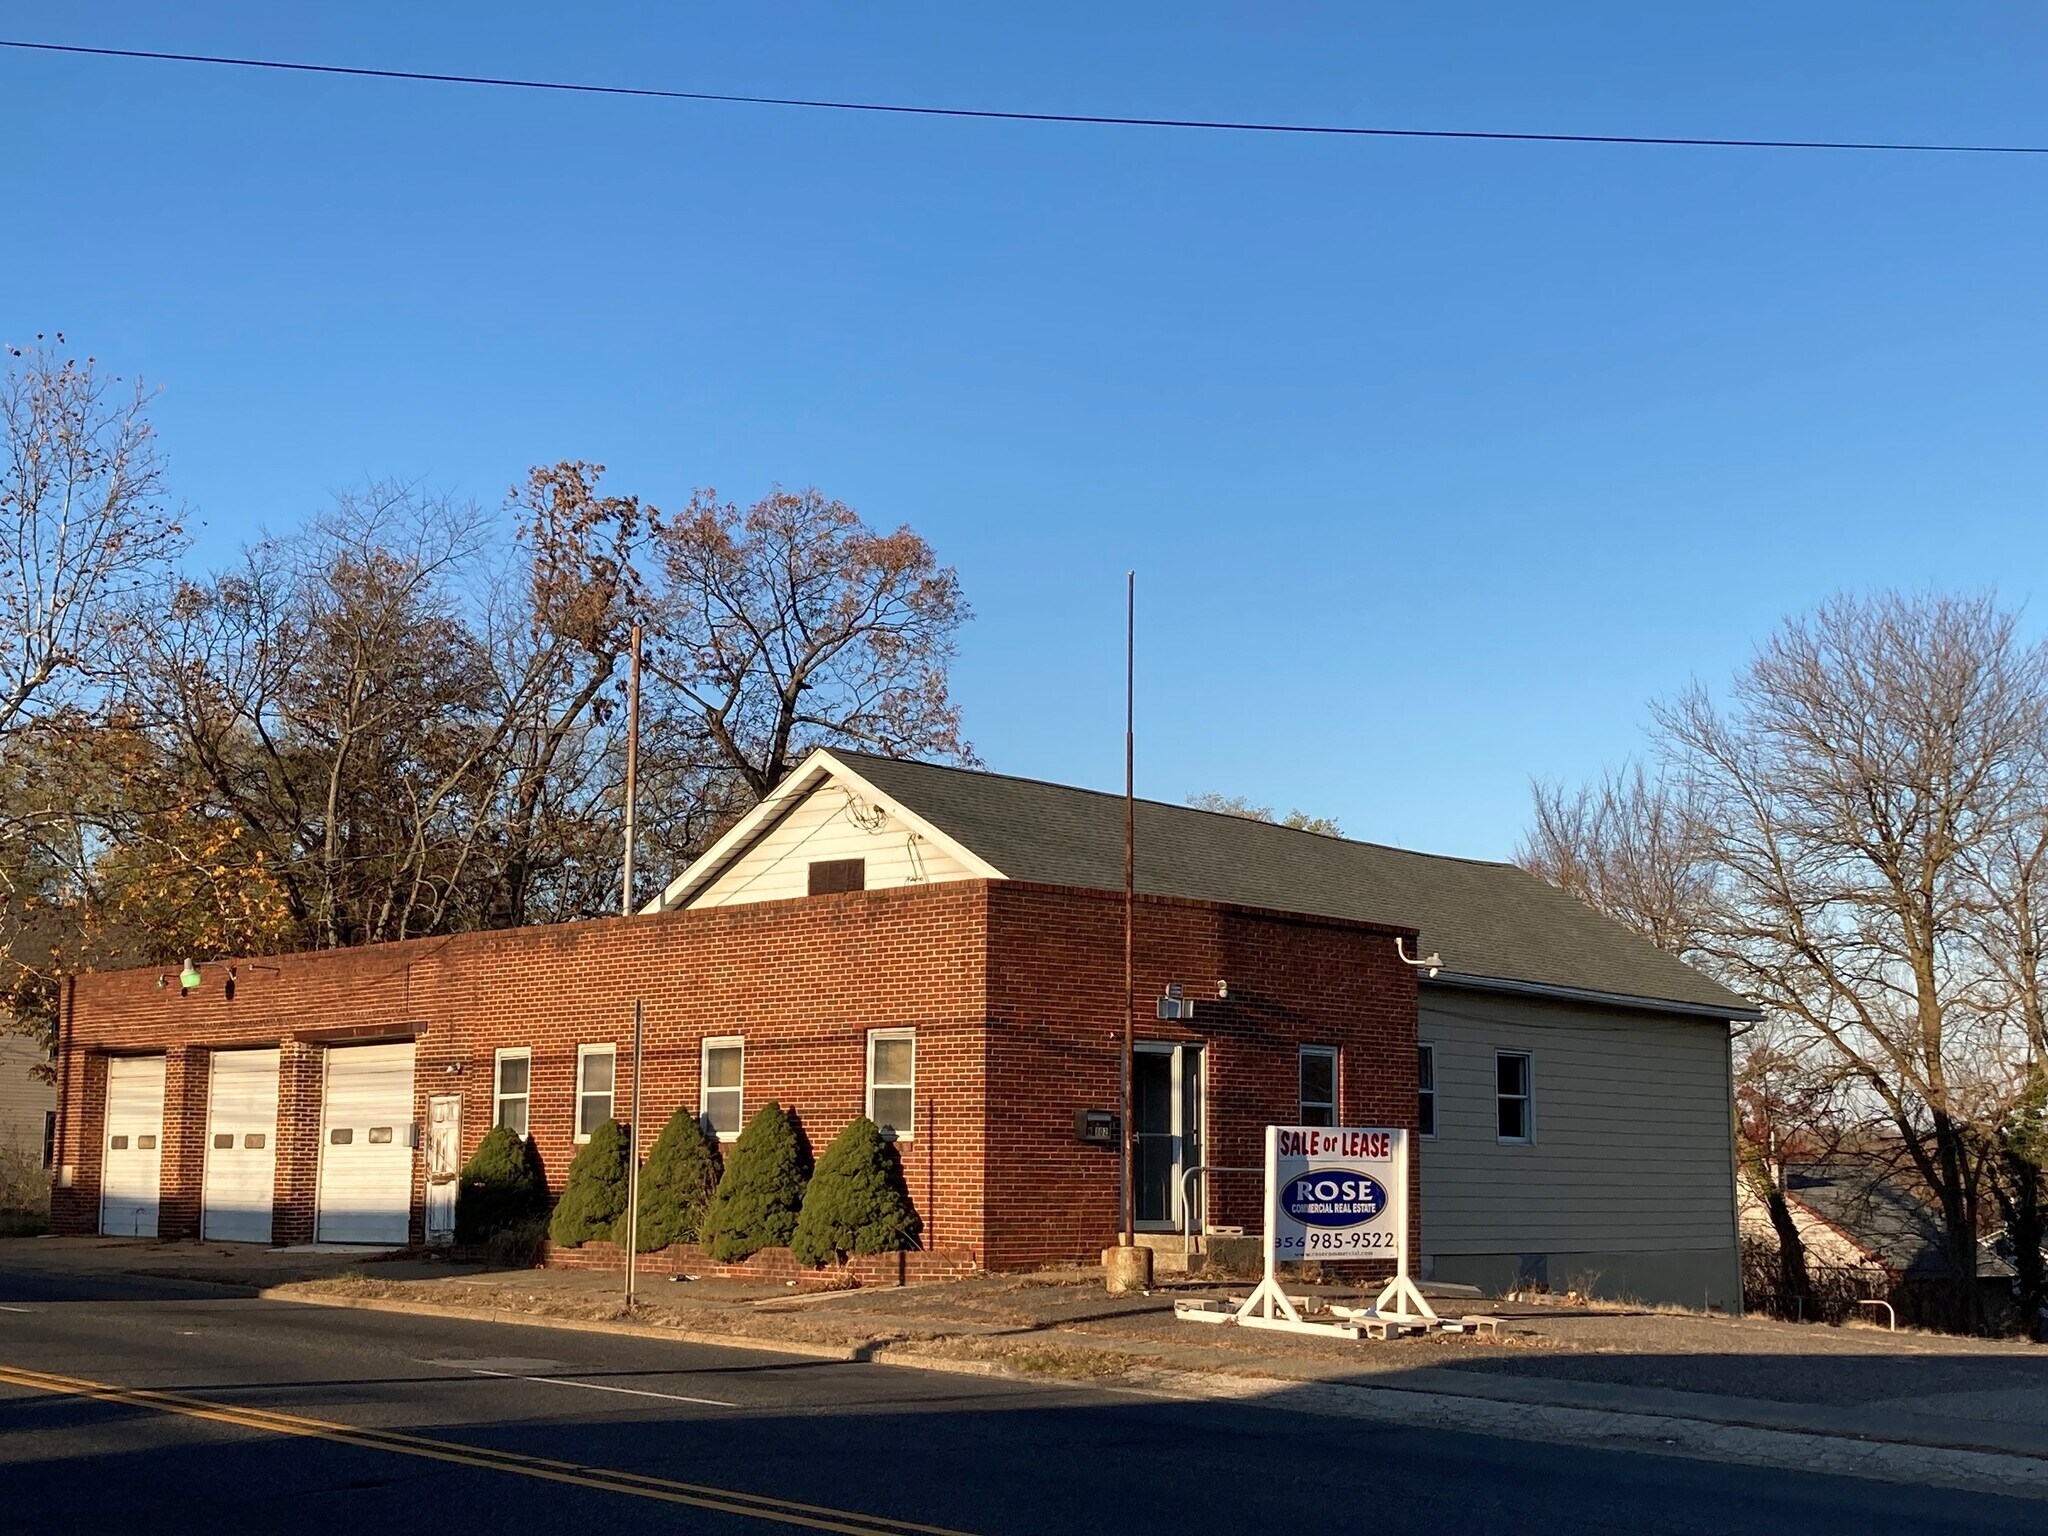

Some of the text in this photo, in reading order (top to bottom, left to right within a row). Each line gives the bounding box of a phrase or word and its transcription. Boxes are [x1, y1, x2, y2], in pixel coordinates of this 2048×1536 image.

[1280, 1131, 1390, 1157] SALE or LEASE
[1297, 1181, 1373, 1201] ROSE
[1292, 1203, 1376, 1213] COMMERCIAL REAL ESTATE
[1310, 1232, 1394, 1249] 985-9522
